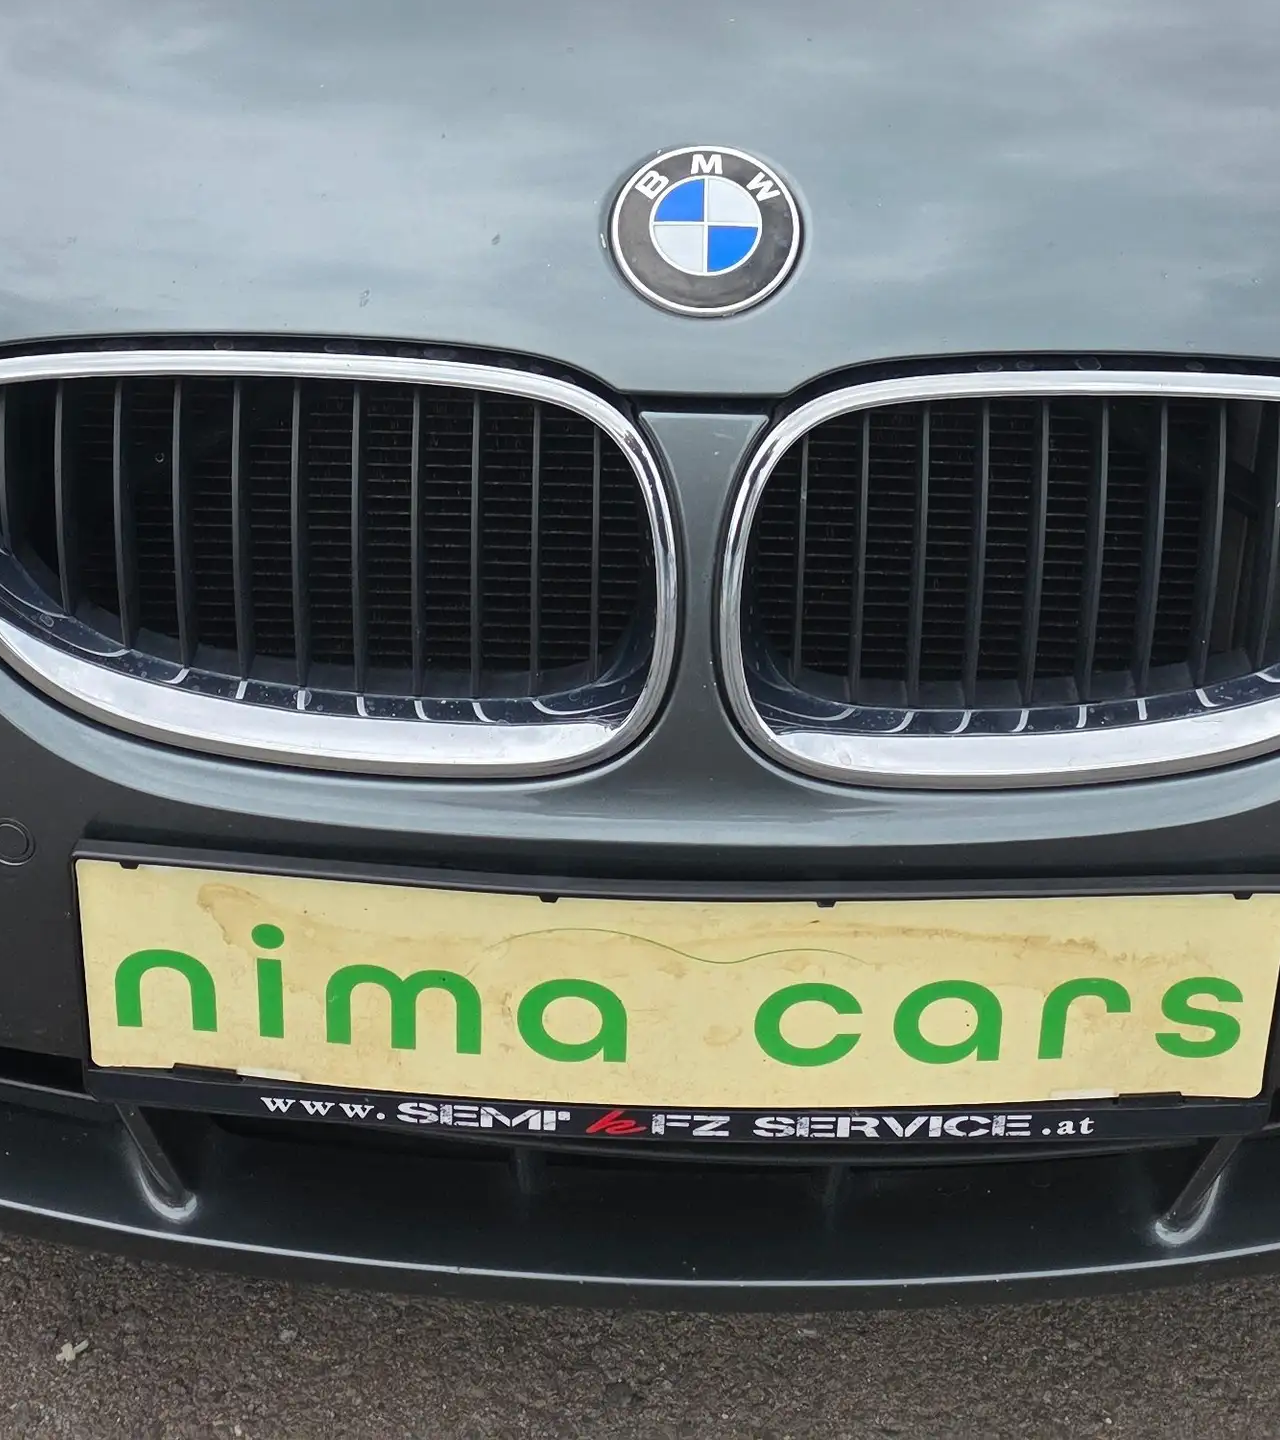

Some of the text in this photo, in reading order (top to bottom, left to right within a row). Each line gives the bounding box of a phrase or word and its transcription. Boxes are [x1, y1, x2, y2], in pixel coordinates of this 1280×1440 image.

[635, 153, 781, 202] BMW
[114, 922, 1244, 1068] nima cars
